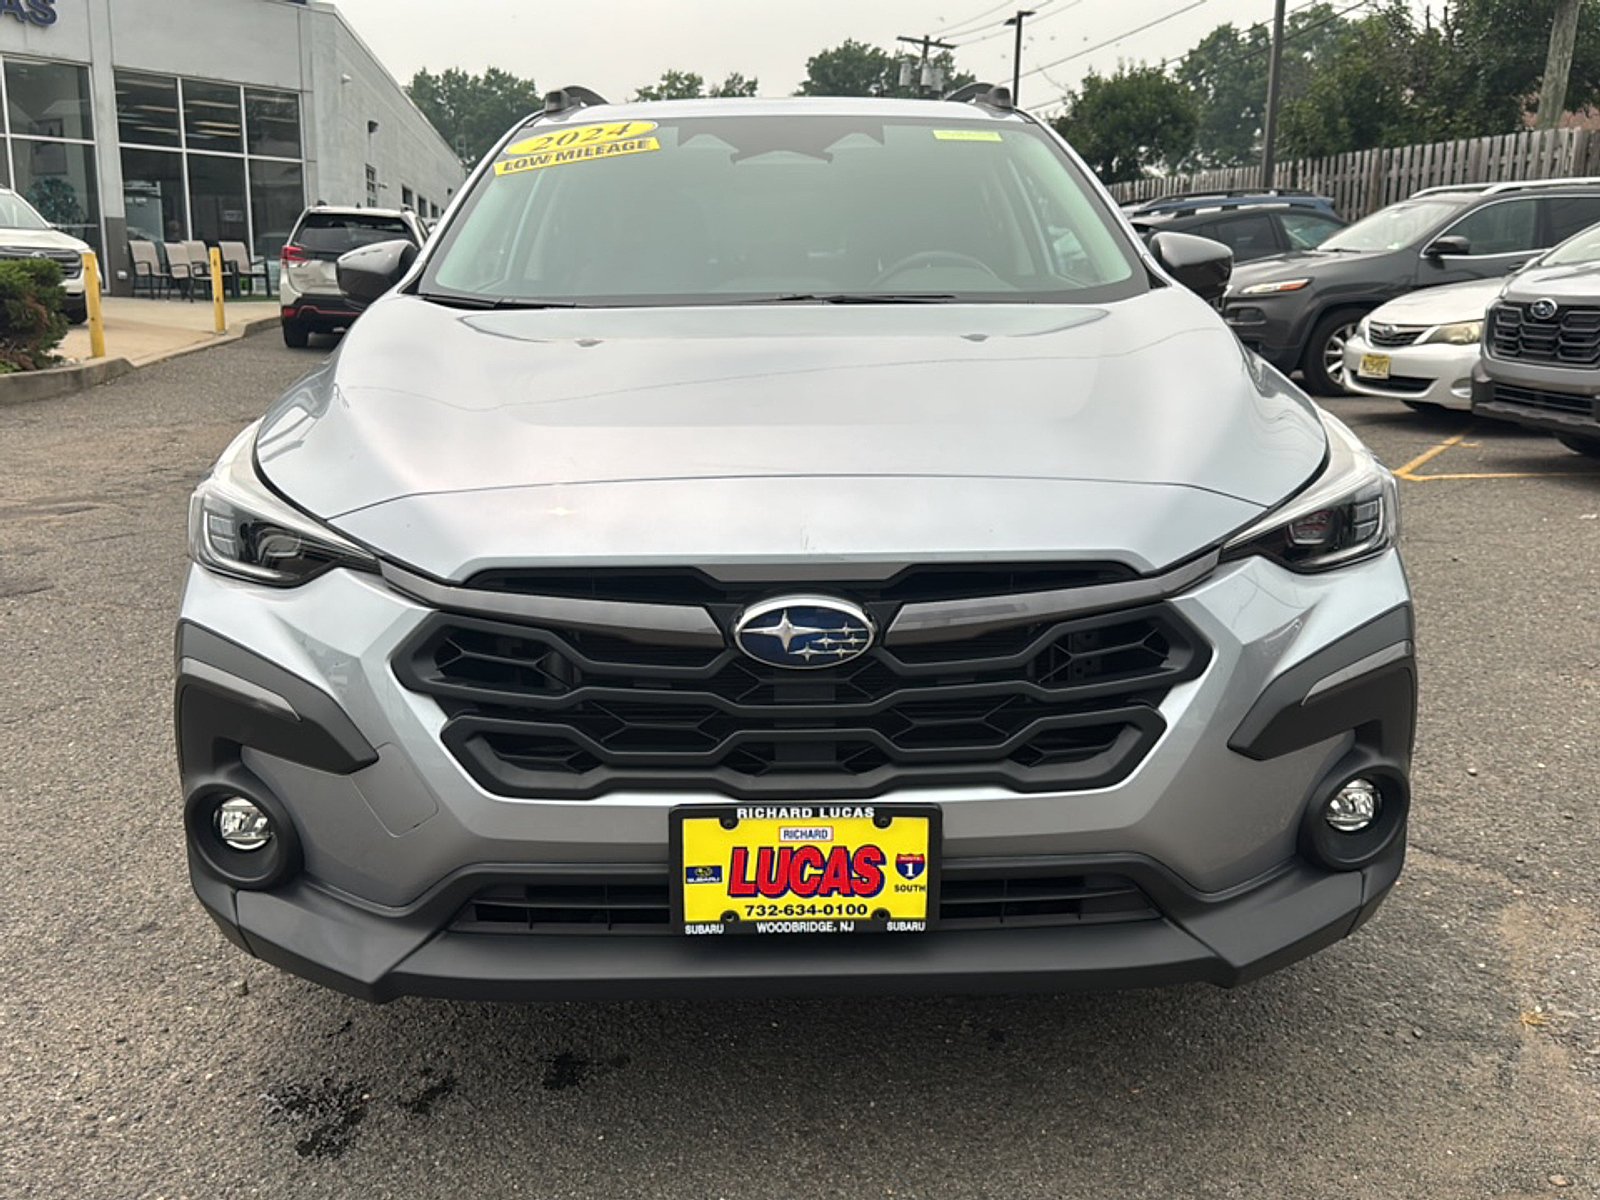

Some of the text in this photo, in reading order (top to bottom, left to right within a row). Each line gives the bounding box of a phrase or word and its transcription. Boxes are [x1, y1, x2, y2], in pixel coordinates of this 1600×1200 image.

[532, 122, 632, 151] 2024
[503, 140, 647, 171] LOW MILEAGE
[736, 807, 875, 818] RICHARD LUCAS
[783, 829, 828, 840] RICHARD
[727, 845, 886, 898] LUCAS
[905, 863, 915, 877] 1
[894, 884, 926, 892] SOUTH
[745, 904, 867, 916] 732-634-0100
[685, 925, 724, 934] SUBARU
[840, 920, 855, 932] NJ
[887, 921, 926, 931] SUBARU
